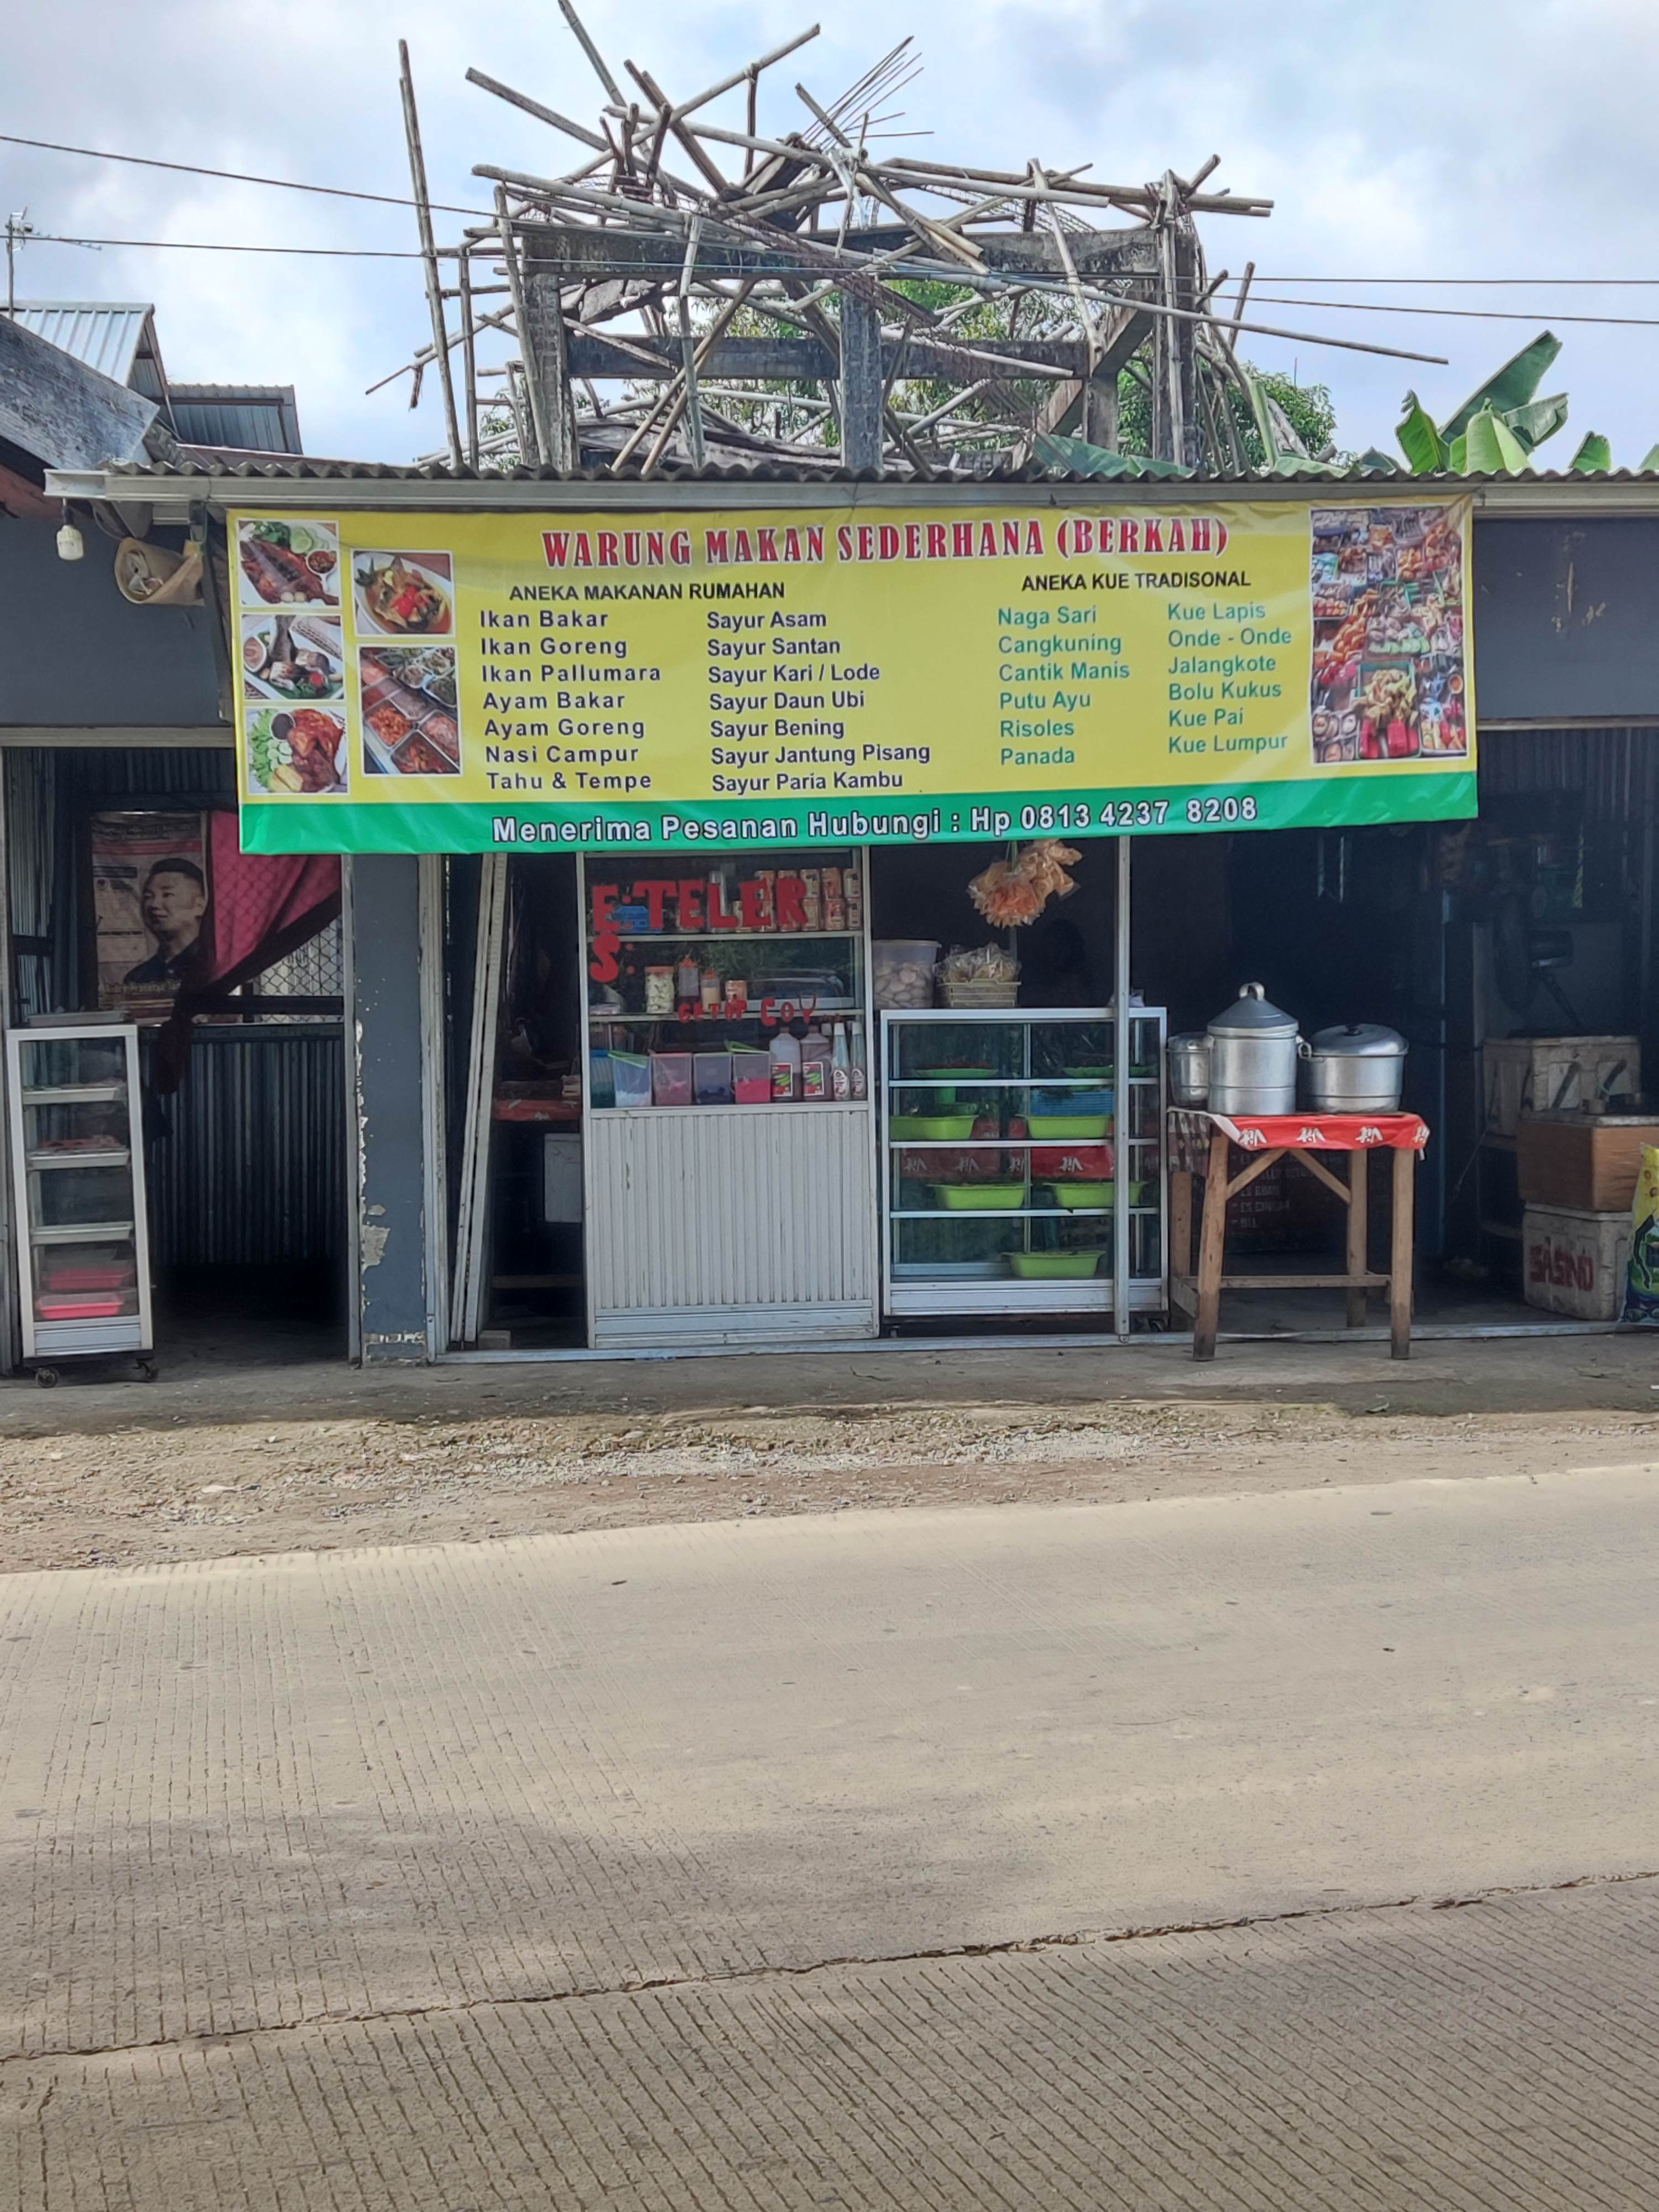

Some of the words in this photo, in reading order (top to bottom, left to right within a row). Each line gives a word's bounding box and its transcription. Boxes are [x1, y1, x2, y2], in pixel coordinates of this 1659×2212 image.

[541, 530, 691, 567] WARUNG
[705, 526, 825, 564] MAKAN
[837, 520, 1044, 561] SEDERHANA
[1057, 517, 1228, 559] (BERKAH)
[509, 585, 579, 601] ANEKA
[584, 583, 682, 600] MAKANAN
[689, 582, 784, 599] RUMAHAN
[1021, 574, 1087, 591] ANEKA
[1092, 573, 1129, 589] KUE
[1135, 571, 1251, 588] TRADISONAL
[481, 610, 529, 628] Ikan
[540, 610, 608, 627] Bakar
[707, 611, 765, 633] Sayur
[770, 611, 826, 628] Asam
[998, 608, 1050, 629] Naga
[1057, 606, 1096, 624] Sari
[1168, 603, 1206, 620] Kue
[1213, 603, 1265, 623] Lapis
[482, 638, 530, 655] Ikan
[540, 637, 627, 659] Goreng
[998, 635, 1121, 658] Cangkuning
[1168, 630, 1220, 647] Onde
[1240, 628, 1291, 645] Onde
[707, 639, 766, 660] Sayur
[772, 638, 840, 655] Santan
[482, 665, 531, 682] Ikan
[541, 664, 660, 682] Pallumara
[708, 666, 767, 687] Sayur
[774, 664, 812, 682] Kari
[818, 664, 825, 681] /
[831, 663, 879, 681] Lode
[999, 663, 1063, 682] Cantik
[1071, 662, 1130, 679] Manis
[1168, 655, 1276, 676] Jalangkote
[1000, 692, 1046, 709] Putu
[1052, 691, 1091, 712] Ayu
[1169, 682, 1213, 701] Bolu
[1222, 681, 1281, 698] Kukus
[483, 692, 547, 714] Ayam
[557, 691, 625, 708] Bakar
[709, 693, 768, 714] Sayur
[774, 692, 825, 709] Daun
[832, 690, 864, 708] Ubi
[1000, 719, 1074, 737] Risoles
[1169, 709, 1207, 727] Kue
[1214, 708, 1243, 726] Pai
[484, 719, 548, 740] Ayam
[558, 718, 644, 739] Goreng
[711, 720, 769, 742] Sayur
[775, 718, 844, 739] Bening
[1169, 736, 1206, 753] Kue
[1214, 735, 1287, 754] Lumpur
[486, 745, 537, 763] Nasi
[546, 745, 639, 766] Campur
[711, 747, 769, 769] Sayur
[775, 746, 855, 766] Jantung
[863, 744, 930, 764] Pisang
[1001, 747, 1074, 765] Panada
[486, 772, 542, 789] Tahu
[552, 771, 567, 789] &
[575, 772, 651, 793] Tempe
[712, 774, 770, 796] Sayur
[776, 773, 826, 790] Paria
[833, 770, 902, 789] Kambu
[492, 815, 651, 842] Menerima
[661, 814, 797, 840] Pesanan
[807, 808, 940, 839] Hubungi
[970, 807, 1011, 836] Hp
[1020, 802, 1091, 830] 0813
[1099, 800, 1170, 826] 4237
[1186, 796, 1257, 823] 8208
[632, 877, 808, 930] TELER
[1058, 1156, 1084, 1172] Vit
